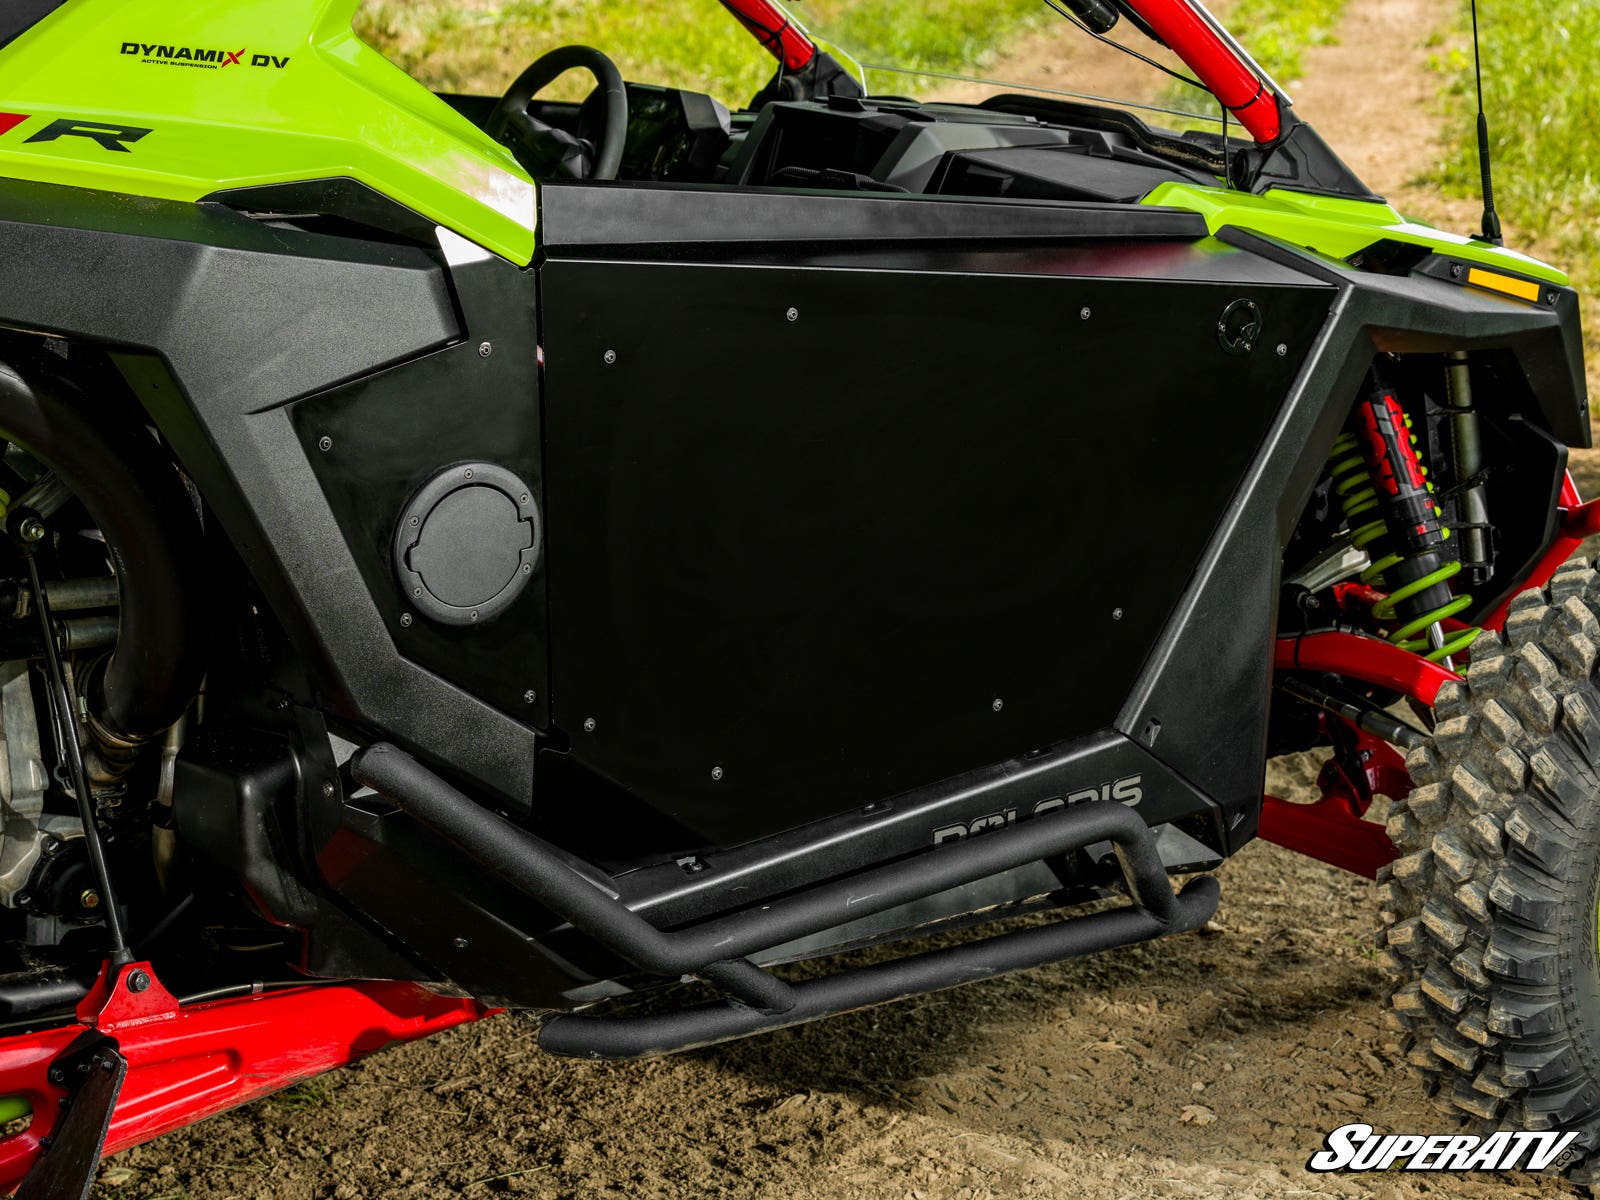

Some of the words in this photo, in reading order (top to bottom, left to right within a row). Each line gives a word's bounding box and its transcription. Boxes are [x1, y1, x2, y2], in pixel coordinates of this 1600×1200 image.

[120, 42, 246, 68] DYNAMIX
[251, 54, 290, 69] DV
[141, 58, 169, 66] ACTIVE
[170, 61, 218, 70] SUSPENSION
